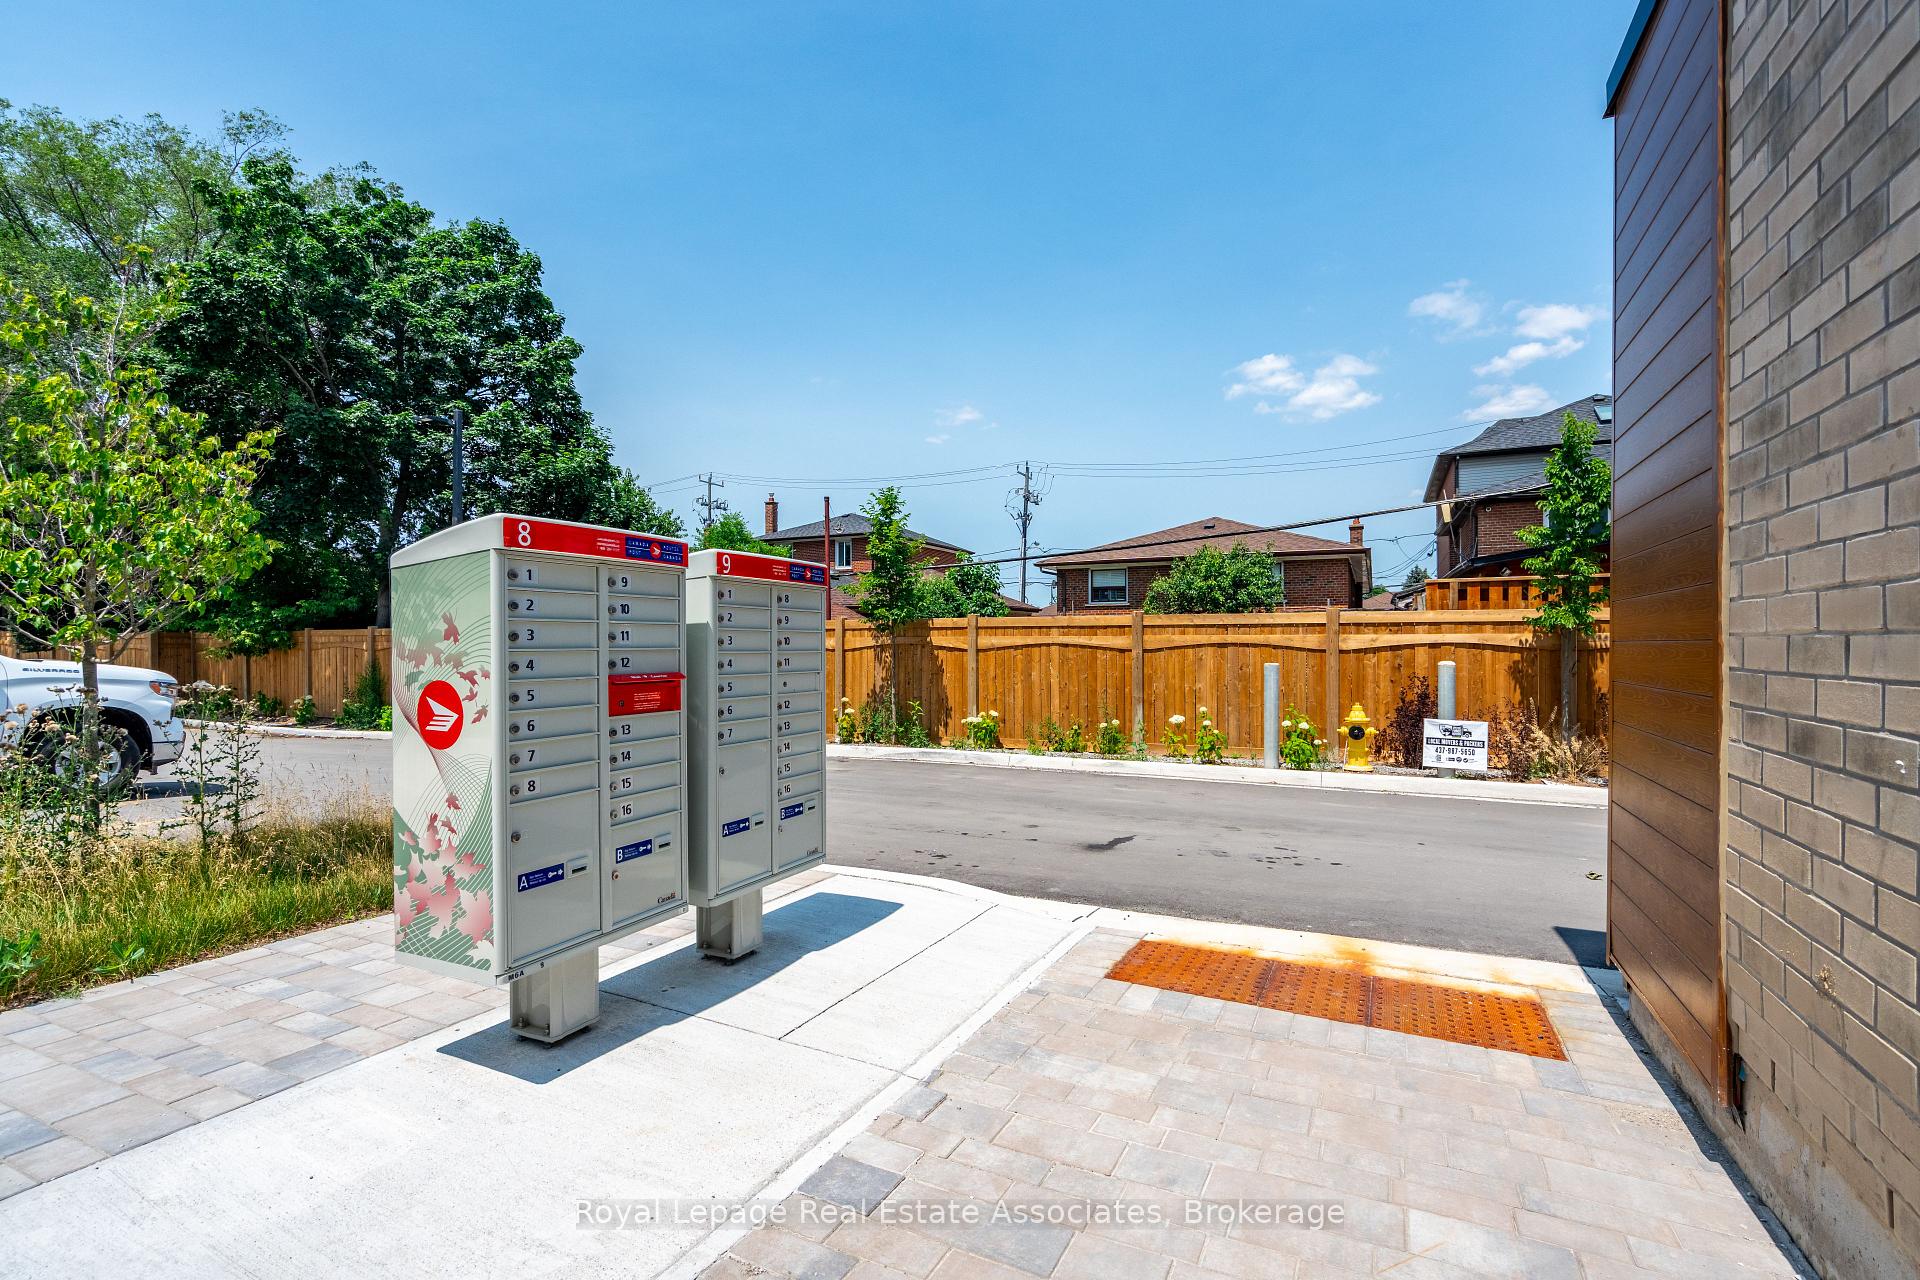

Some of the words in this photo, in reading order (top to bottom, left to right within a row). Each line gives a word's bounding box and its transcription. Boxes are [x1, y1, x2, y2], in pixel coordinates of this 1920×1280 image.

[518, 522, 532, 546] 8
[722, 555, 730, 574] 9
[527, 569, 532, 580] 1
[622, 577, 628, 587] 9
[728, 590, 732, 598] 1
[784, 594, 789, 603] 8
[526, 599, 534, 611] 2
[620, 604, 630, 614] 10
[728, 613, 732, 622] 2
[784, 616, 789, 624] 9
[527, 629, 534, 640] 3
[620, 631, 630, 640] 11
[728, 636, 732, 645] 3
[784, 637, 790, 645] 10
[526, 660, 534, 671] 4
[621, 658, 630, 668] 12
[728, 659, 732, 668] 4
[784, 658, 790, 666] 11
[728, 682, 732, 691] 5
[527, 690, 535, 701] 5
[784, 700, 790, 708] 12
[728, 706, 732, 714] 6
[527, 720, 535, 731] 6
[621, 724, 631, 735] 13
[784, 721, 790, 730] 13
[728, 729, 732, 738] 7
[784, 742, 790, 751] 14
[528, 750, 535, 762] 7
[621, 751, 631, 762] 14
[784, 763, 790, 772] 15
[527, 780, 536, 792] 8
[621, 778, 631, 789] 15
[784, 784, 791, 793] 16
[621, 804, 632, 816] 16
[781, 810, 786, 818] B
[723, 826, 728, 835] A
[617, 849, 623, 861] B
[520, 876, 528, 890] A
